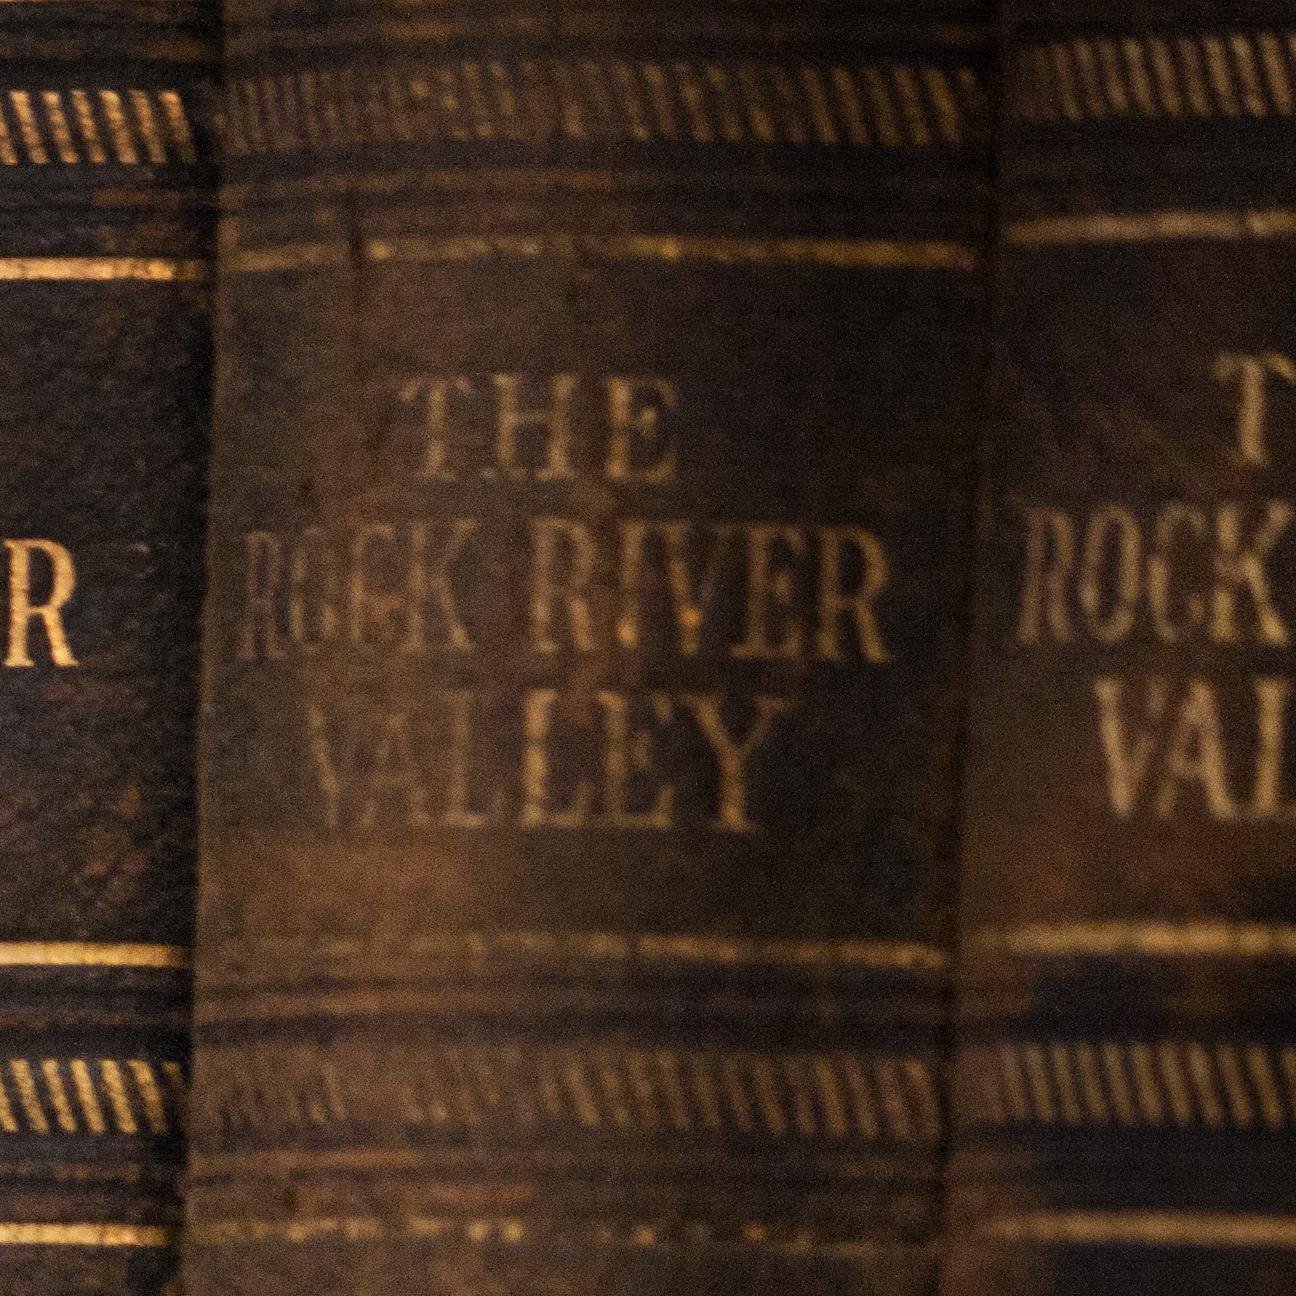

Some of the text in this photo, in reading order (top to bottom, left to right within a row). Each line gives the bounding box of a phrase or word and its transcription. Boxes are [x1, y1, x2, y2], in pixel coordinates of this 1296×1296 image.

[406, 372, 678, 482] THE
[236, 515, 893, 664] ROCK RIVER
[1018, 500, 1290, 645] ROCK
